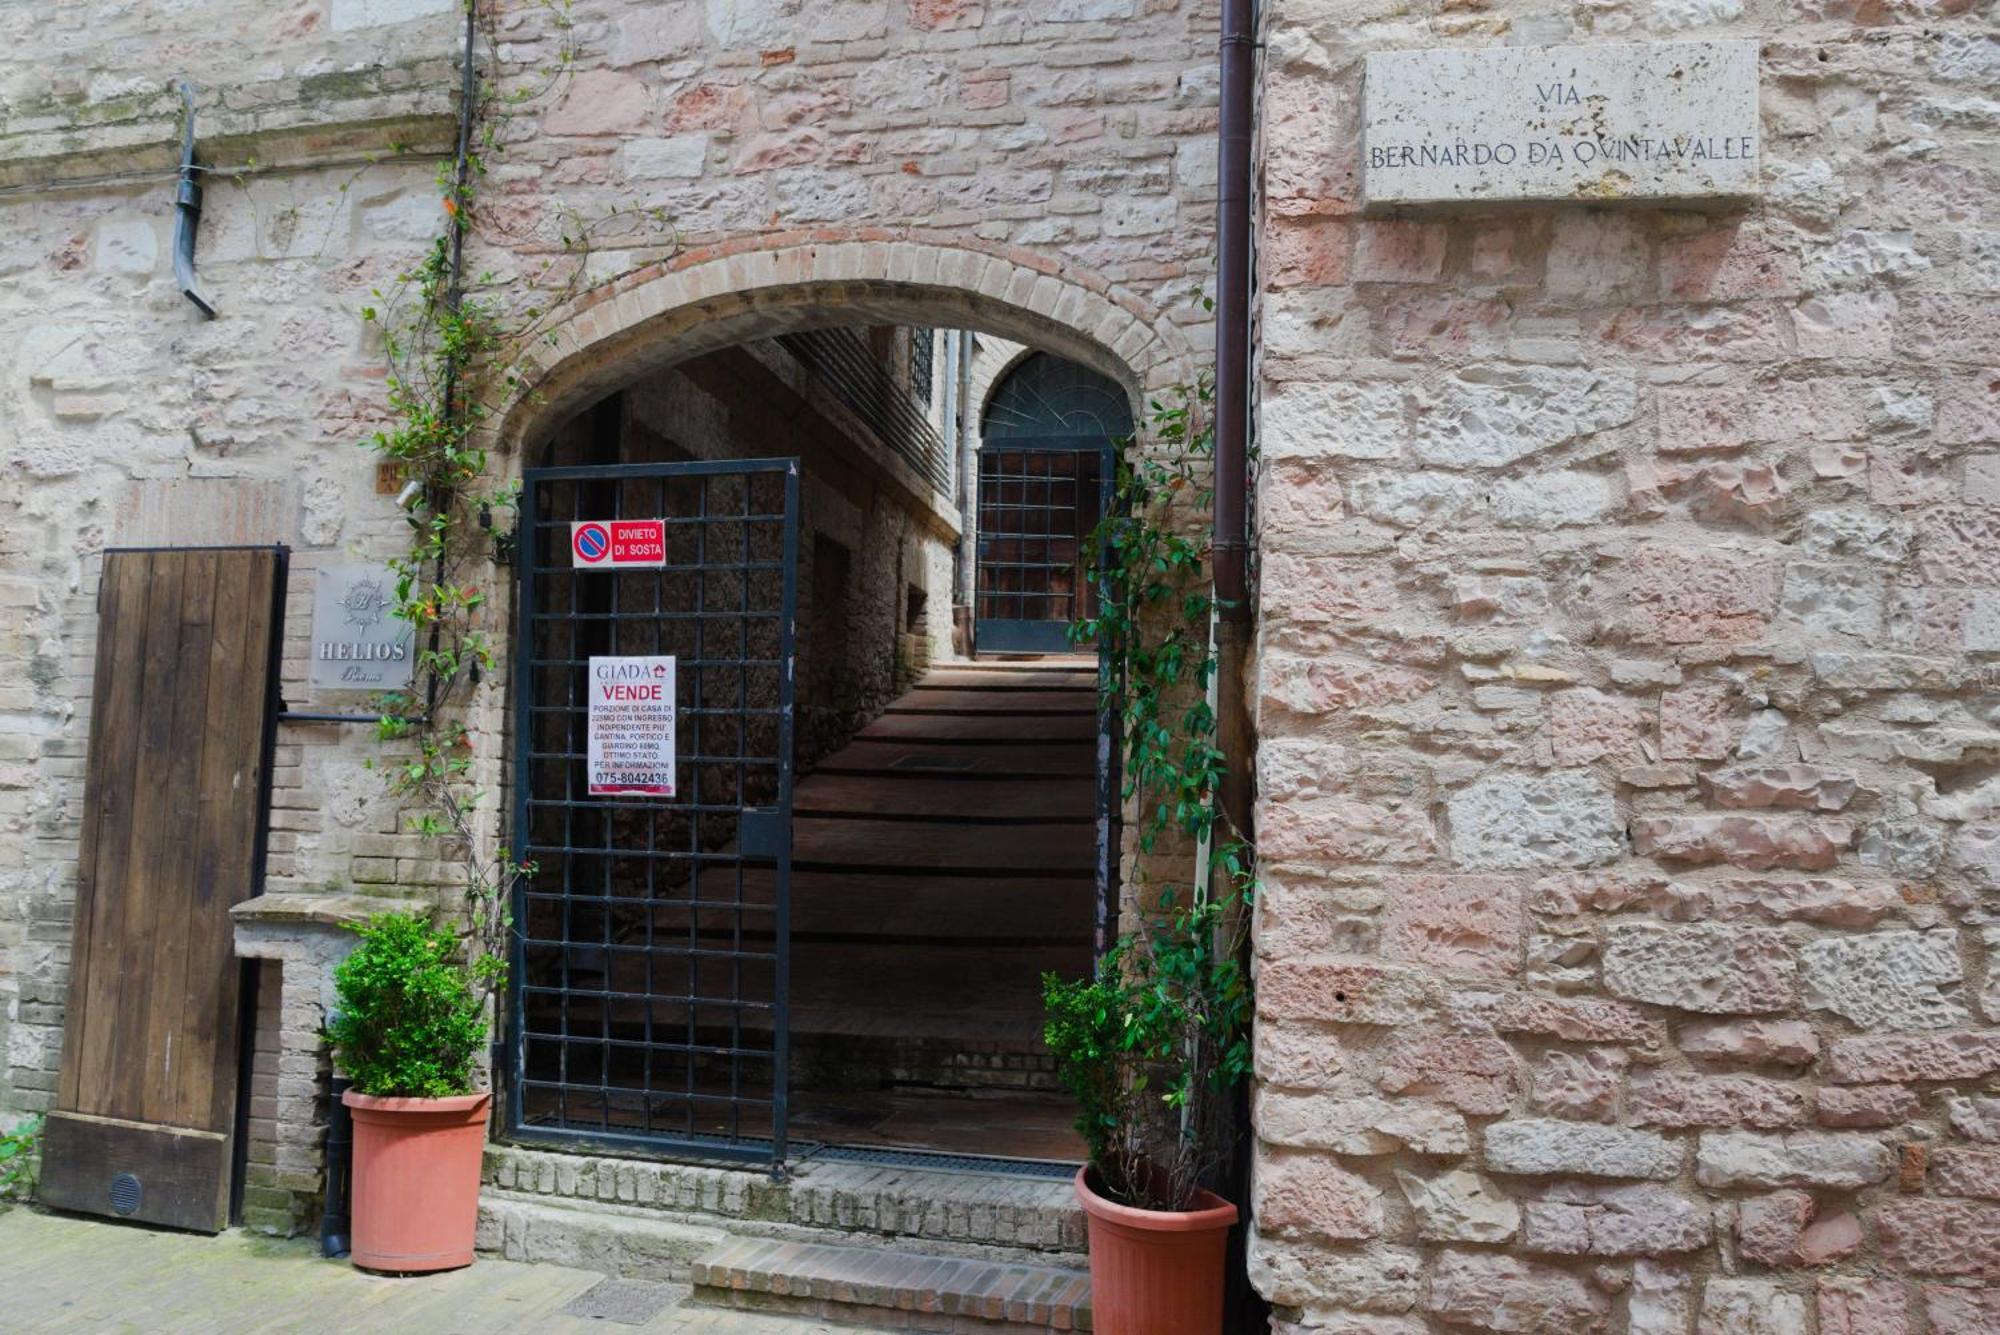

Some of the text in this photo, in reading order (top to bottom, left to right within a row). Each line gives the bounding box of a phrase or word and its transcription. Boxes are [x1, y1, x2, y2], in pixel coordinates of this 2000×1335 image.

[1535, 82, 1582, 106] VIA
[1370, 136, 1755, 170] BERNARDO DA QVINTAVALLE
[618, 528, 657, 540] DIVIETO
[614, 544, 662, 556] DI SOSTA
[319, 642, 406, 662] HELIOS
[596, 664, 651, 680] GIADA
[602, 685, 663, 701] VENDE
[593, 705, 631, 713] PORZIONE
[641, 704, 662, 712] CASA
[664, 704, 672, 712] DI
[617, 714, 633, 722] CON
[634, 714, 673, 722] INGRESSO
[597, 723, 651, 731] INDIPENDENTE
[630, 732, 663, 741] PORTICO
[665, 732, 671, 741] E
[602, 742, 638, 750] GIARDINO
[603, 751, 632, 760] OTTIMO
[594, 760, 669, 769] PER INFORMAZIONI
[596, 772, 669, 784] 075-8042436
